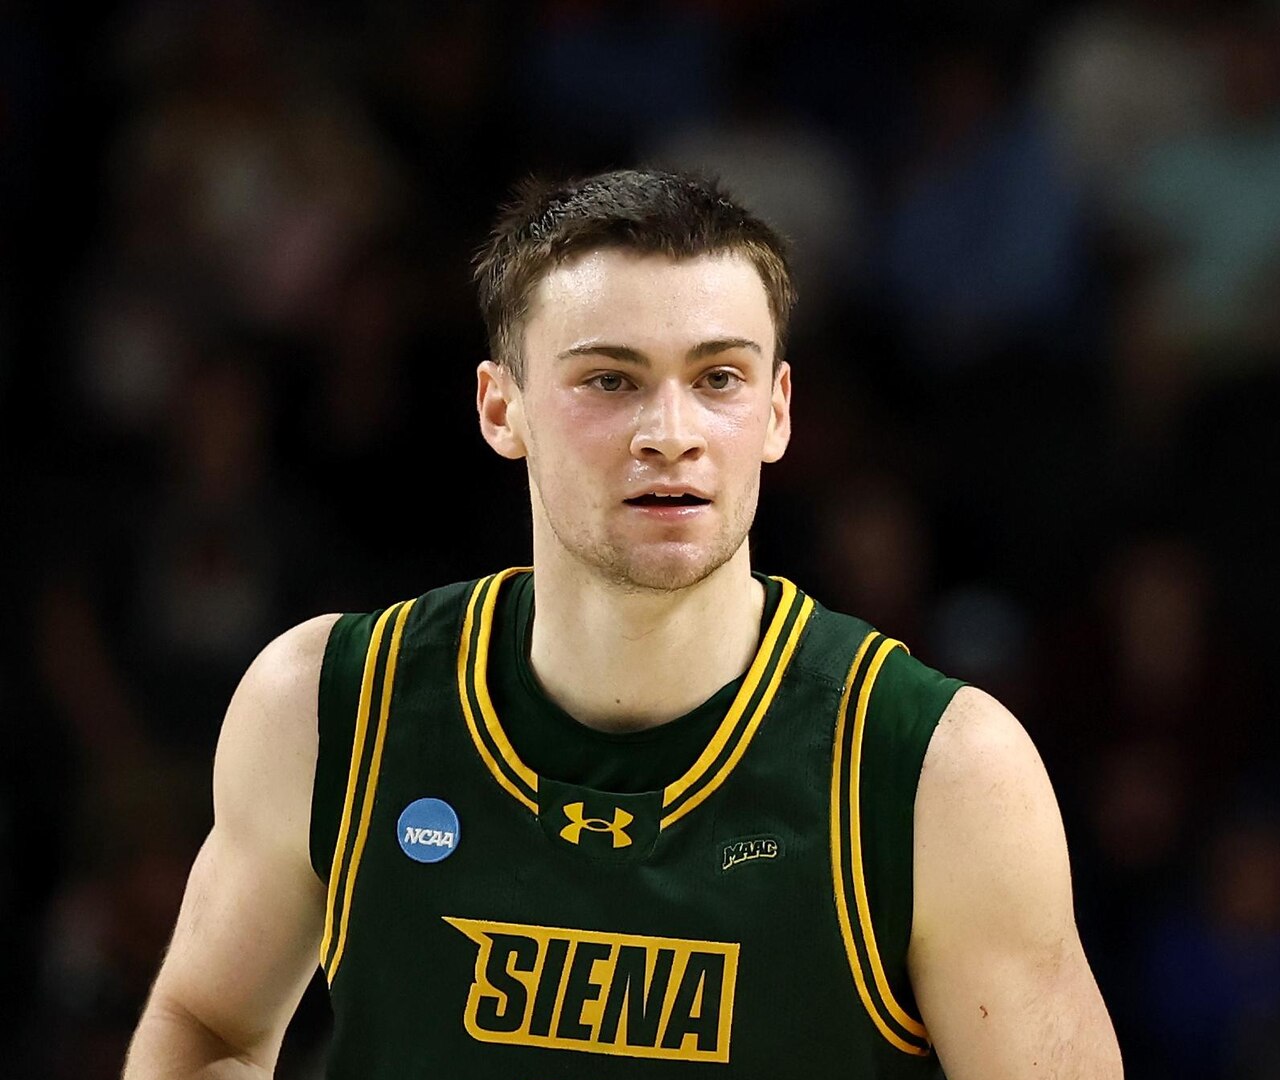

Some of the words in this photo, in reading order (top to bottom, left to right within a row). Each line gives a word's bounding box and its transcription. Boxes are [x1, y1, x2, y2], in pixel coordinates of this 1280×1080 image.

[404, 827, 454, 848] NCAA
[722, 839, 778, 870] MAAC
[474, 931, 721, 1053] SIENA
